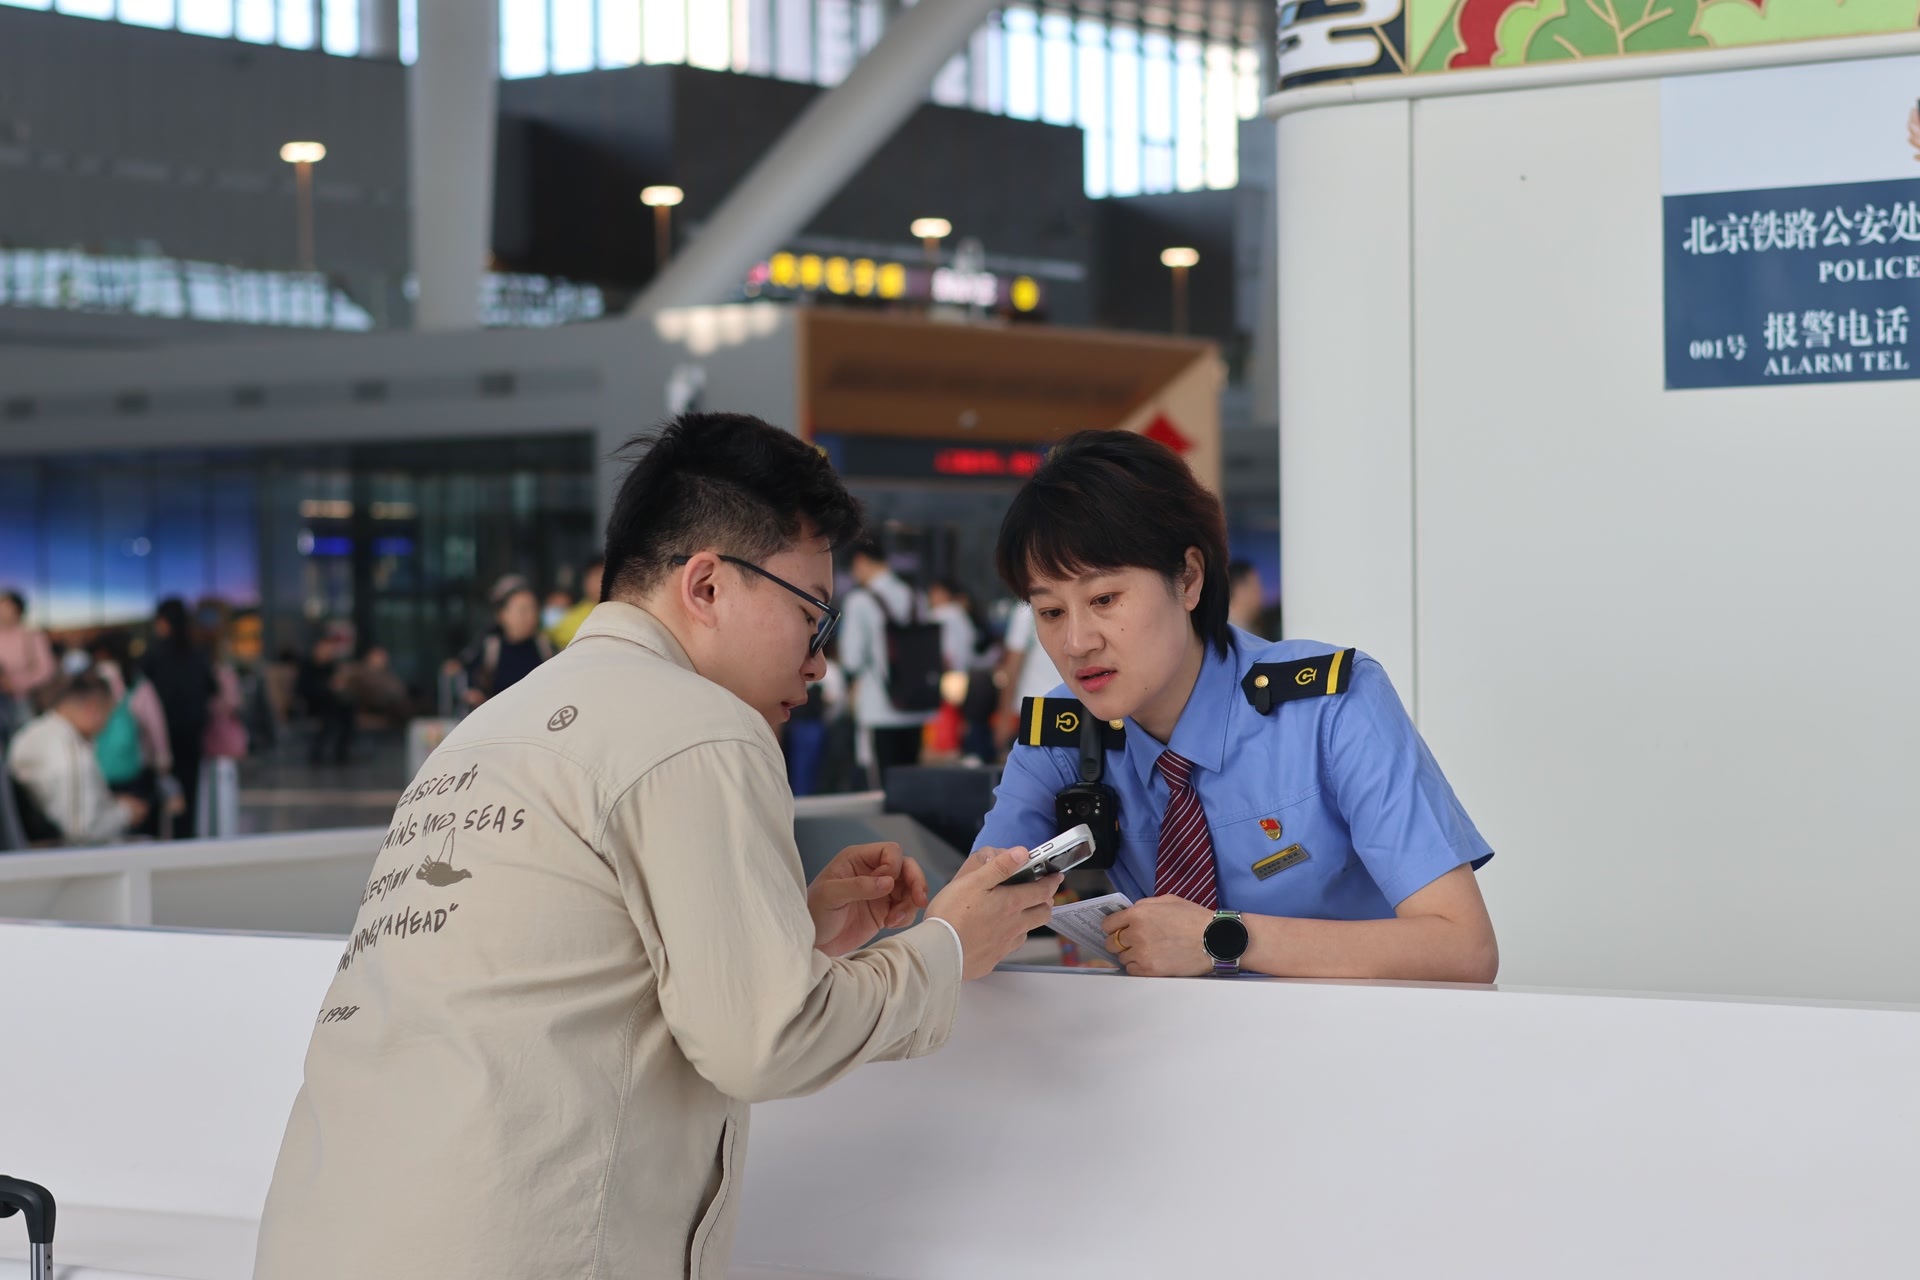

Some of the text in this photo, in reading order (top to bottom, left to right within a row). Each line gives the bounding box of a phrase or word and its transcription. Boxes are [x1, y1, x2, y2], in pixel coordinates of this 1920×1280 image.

[1682, 201, 1920, 255] 北京铁路公安处
[1818, 255, 1920, 283] POLICE
[1763, 305, 1910, 350] 报警电话
[1689, 334, 1747, 361] 001号
[1764, 350, 1909, 376] ALARM TEL
[422, 812, 456, 838] AND
[463, 804, 526, 833] SEAS
